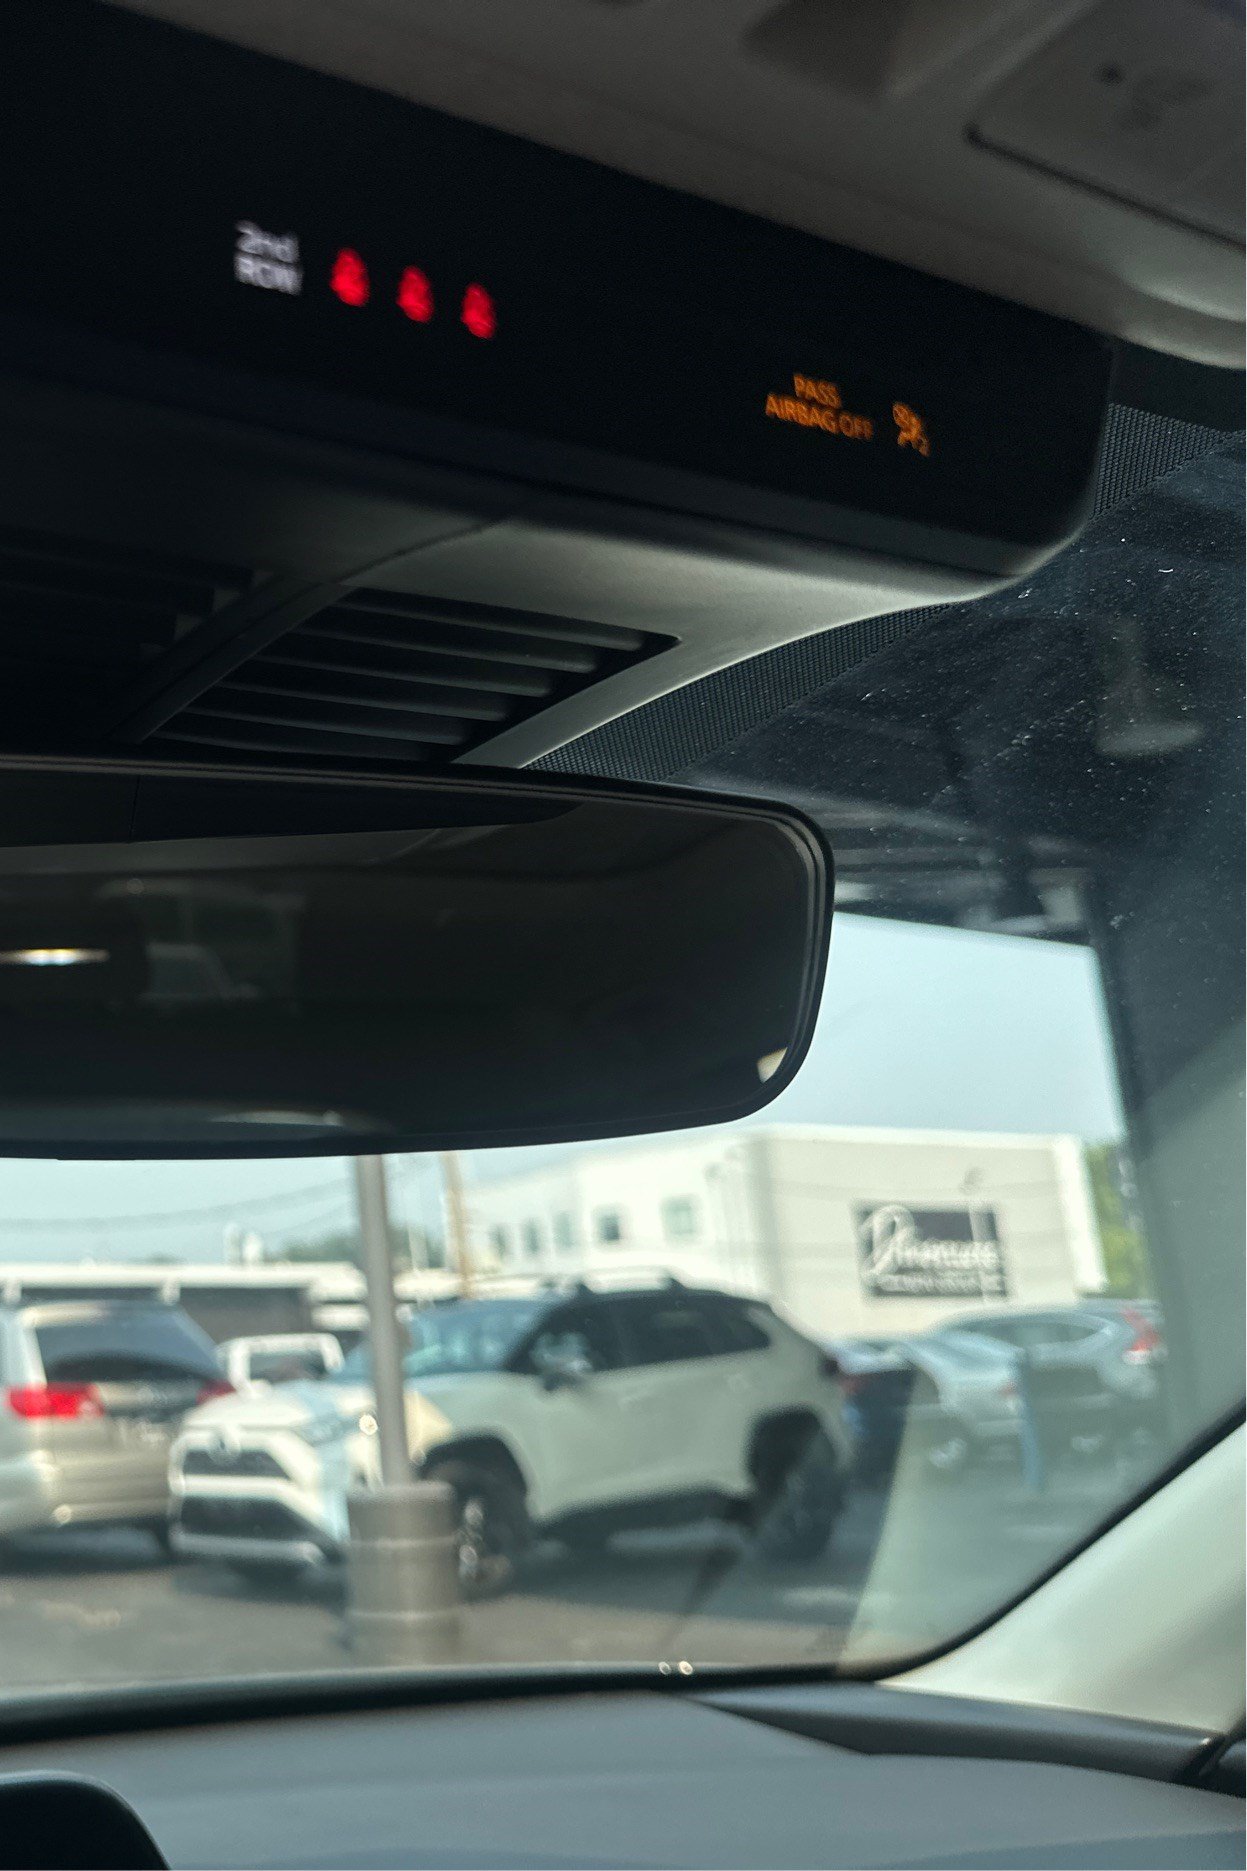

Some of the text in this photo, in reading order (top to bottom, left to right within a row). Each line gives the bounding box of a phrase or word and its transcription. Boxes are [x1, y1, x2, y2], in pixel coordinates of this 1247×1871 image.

[236, 220, 299, 263] 2nd
[234, 254, 303, 295] ROW
[793, 373, 841, 408] PASS
[765, 392, 874, 440] AIRBAG OFF
